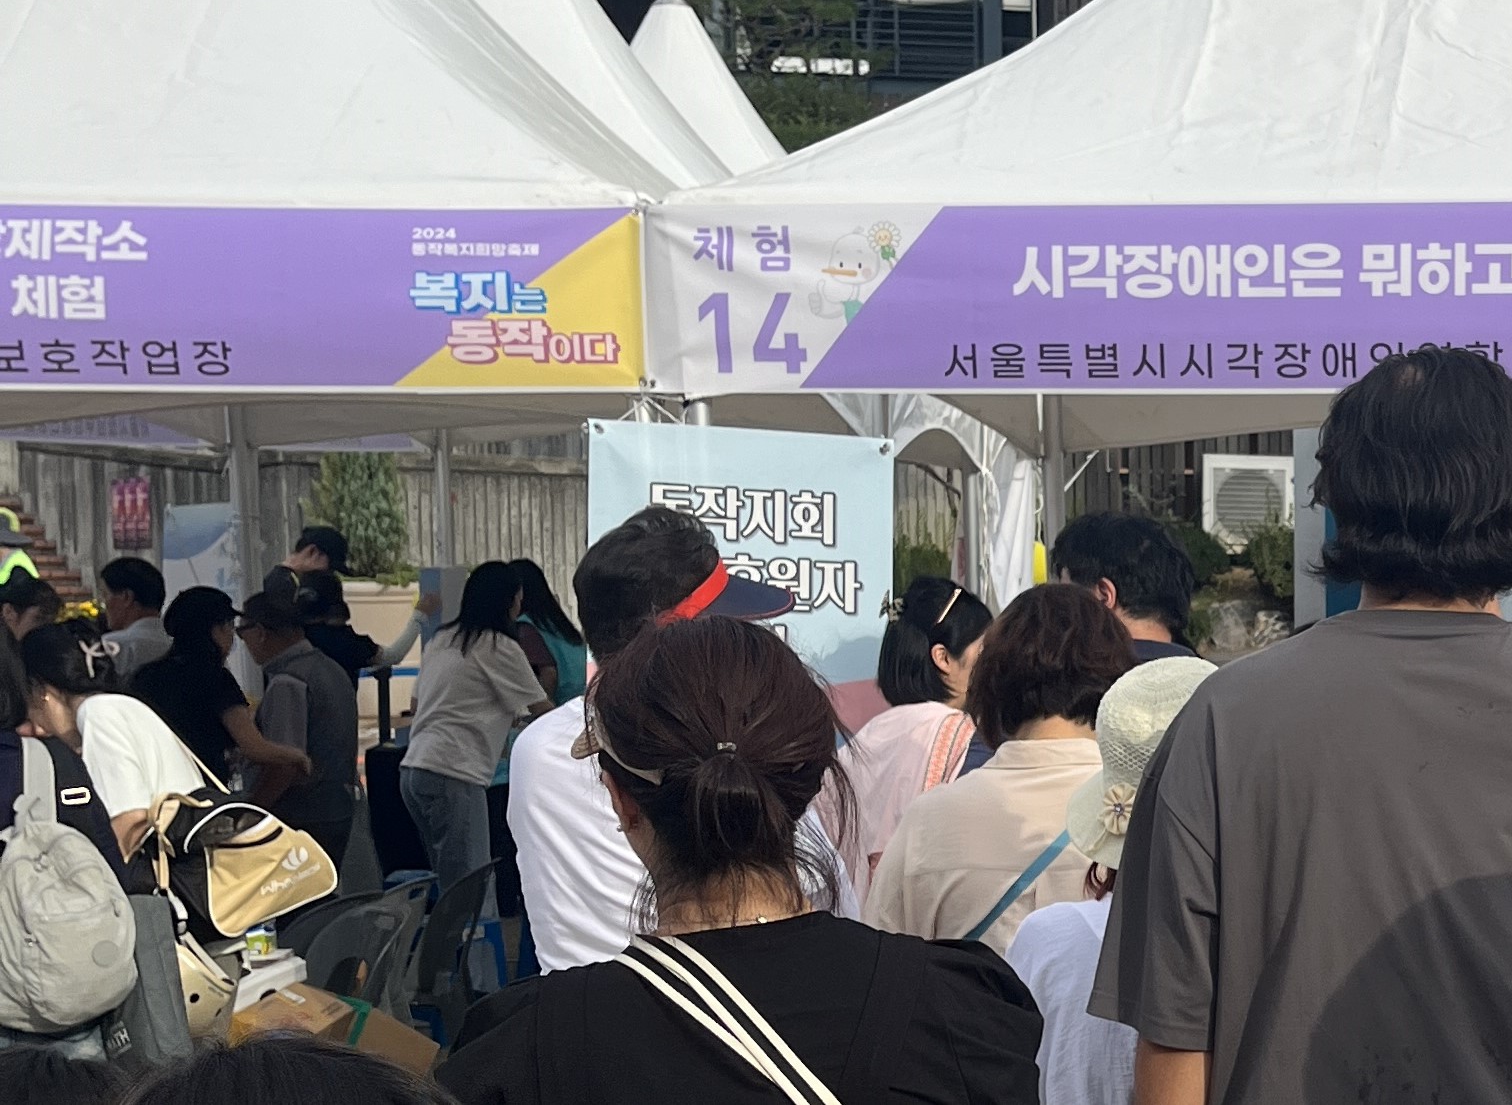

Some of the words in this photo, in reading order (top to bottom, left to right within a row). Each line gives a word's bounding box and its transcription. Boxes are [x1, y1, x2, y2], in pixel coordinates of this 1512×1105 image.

[411, 227, 457, 240] 2024
[408, 270, 548, 315] 복지는
[1012, 242, 1344, 299] 시각장애인은
[10, 274, 107, 321] 체험
[446, 318, 621, 365] 동작이다
[697, 290, 808, 375] 14
